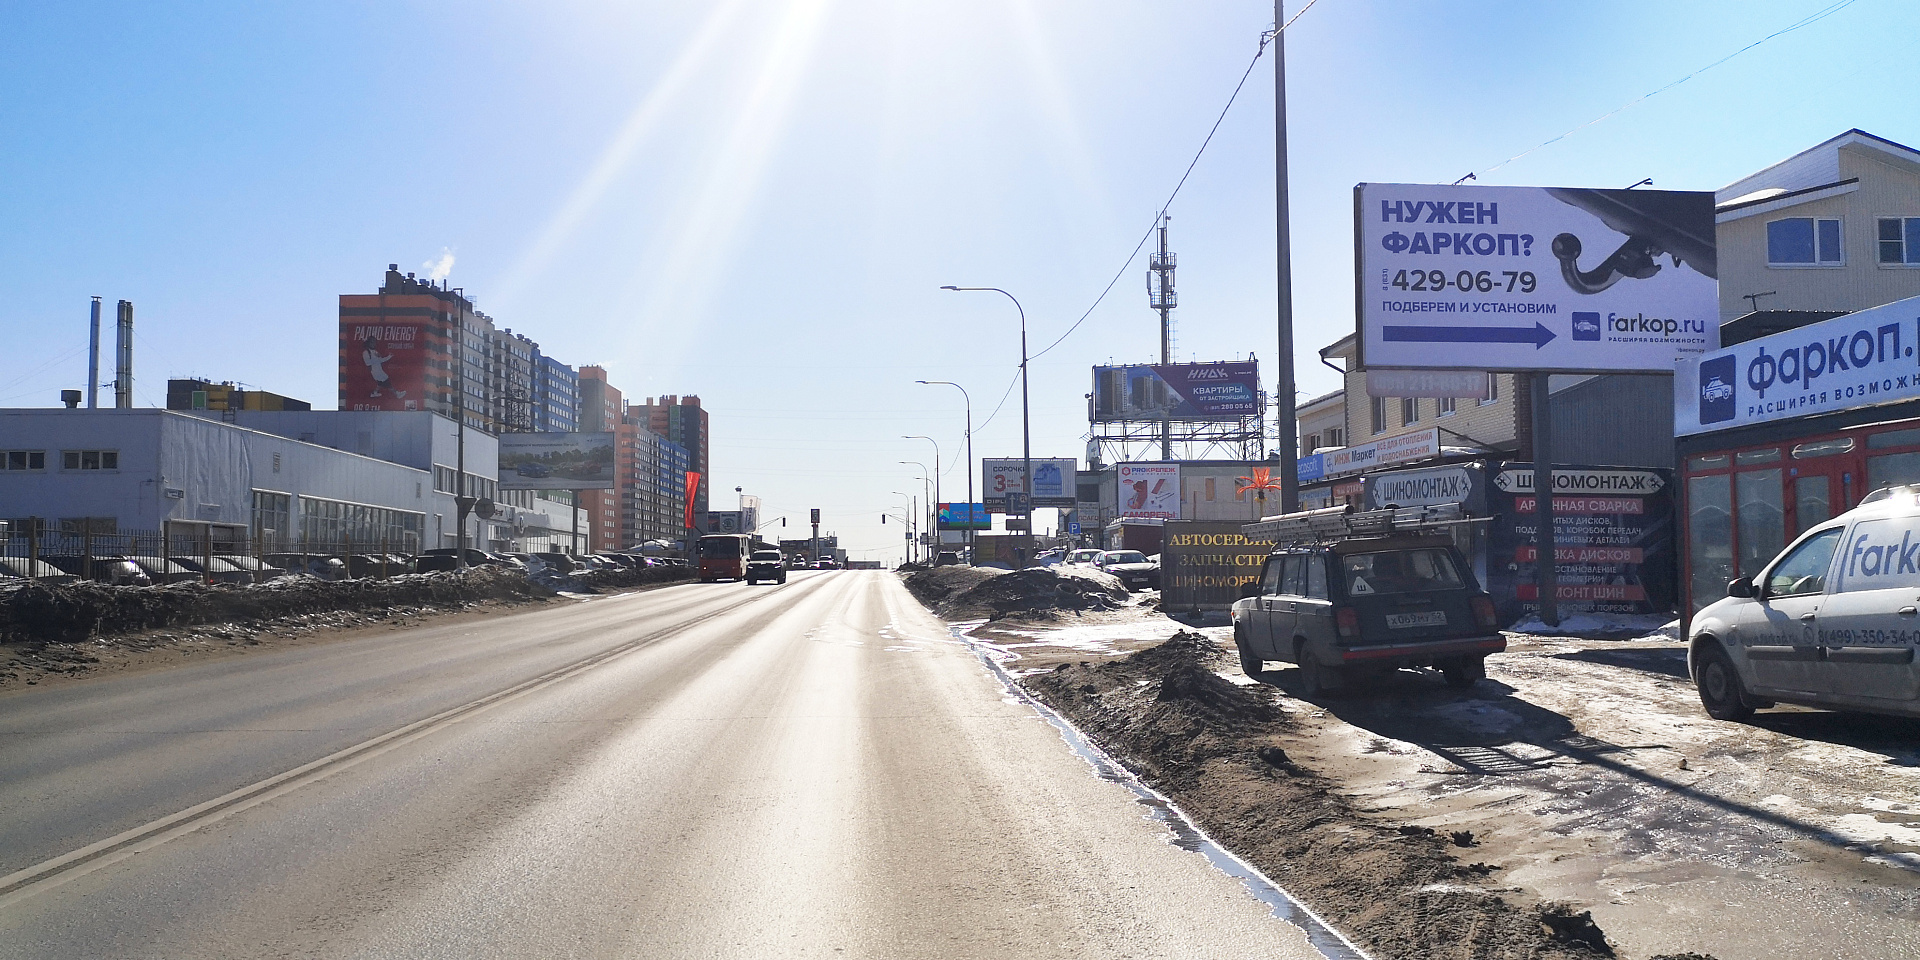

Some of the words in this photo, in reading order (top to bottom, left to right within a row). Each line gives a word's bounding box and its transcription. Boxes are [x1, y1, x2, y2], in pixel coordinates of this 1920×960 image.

[1381, 200, 1498, 225] НУЖЕН
[1381, 231, 1535, 257] ФАРКОП?
[1392, 269, 1537, 293] 429-06-79
[1382, 301, 1456, 313] ПОДБЕРЕМ
[1460, 302, 1469, 312] И
[1472, 302, 1557, 314] УСТАНОВИМ
[1608, 313, 1705, 336] farkop.ru
[354, 326, 383, 341] РАДИО
[385, 326, 418, 341] ENERGY
[1193, 386, 1243, 395] КВАРТИРЫ
[1748, 391, 1827, 416] РАСШИРЯЯ
[1398, 432, 1433, 446] ОТОПЛЕНИЯ
[1351, 448, 1376, 462] Маркет
[1382, 444, 1430, 462] ВОДОСНАБЖЕНИЯ
[1298, 458, 1318, 474] ecosoft
[994, 475, 1007, 494] 3
[1384, 476, 1460, 501] ШИНОМОНТАЖ
[1516, 474, 1646, 490] ШОМОНТАЖ
[1520, 500, 1585, 511] АРННАЯ
[1588, 500, 1639, 512] СВАРКА
[1072, 524, 1078, 533] P
[1567, 526, 1606, 534] КОРОБОК
[1608, 527, 1644, 536] ПЕРЕДАЧ,
[1180, 554, 1268, 566] ЗАПЧАСТИ
[1528, 550, 1576, 560] ПВКА
[1578, 550, 1632, 562] ДИСКОВ
[1848, 530, 1920, 577] fark
[1356, 584, 1366, 592] Ш
[1593, 587, 1624, 598] ШИН
[1598, 604, 1634, 612] ПОРЕЗОВ
